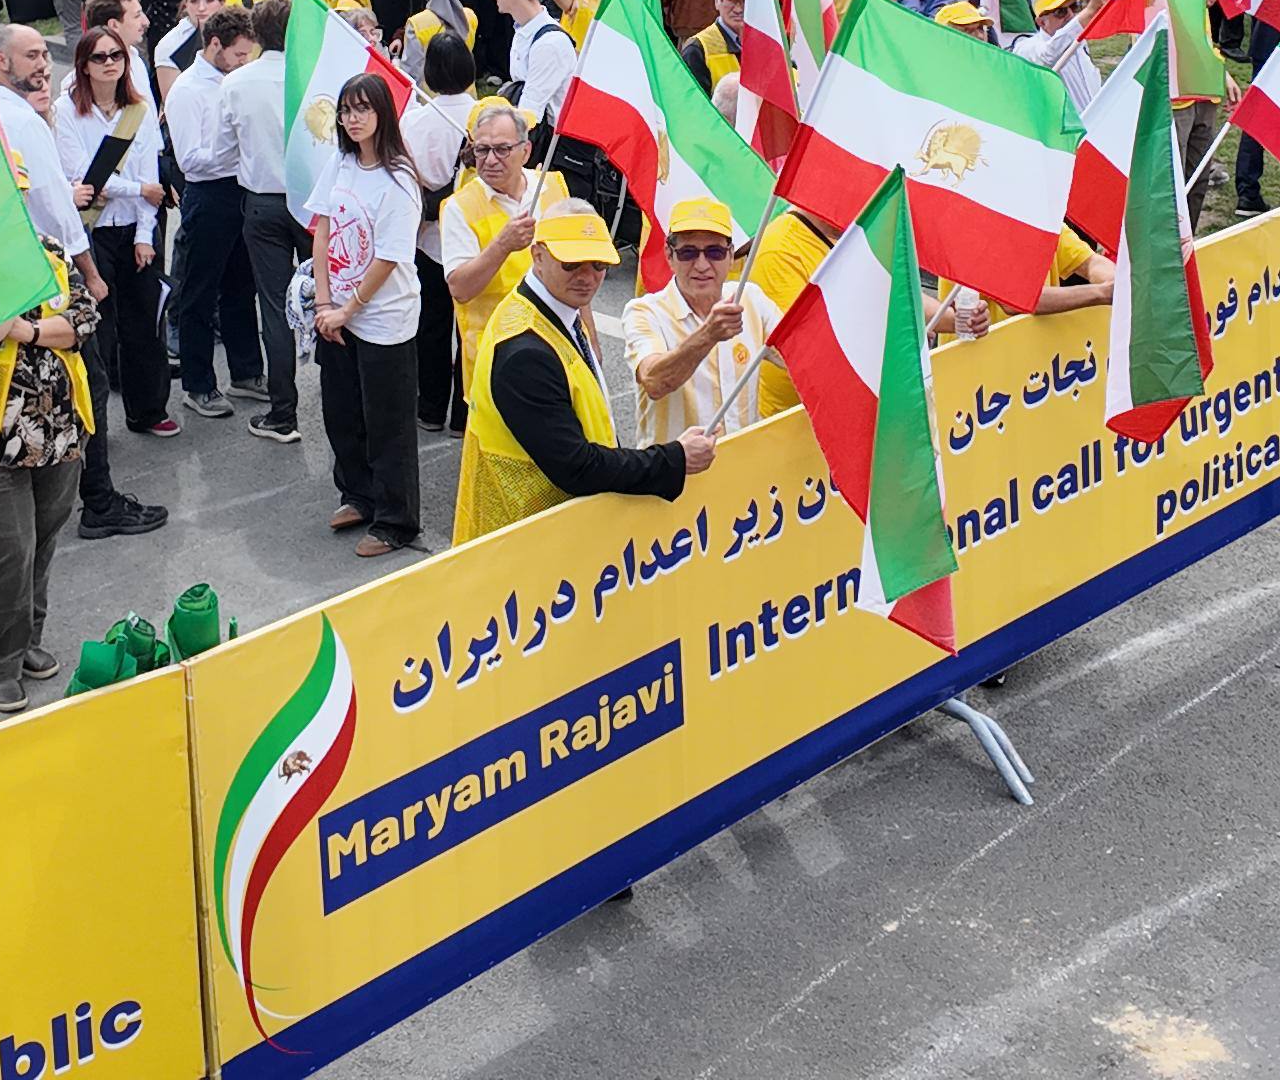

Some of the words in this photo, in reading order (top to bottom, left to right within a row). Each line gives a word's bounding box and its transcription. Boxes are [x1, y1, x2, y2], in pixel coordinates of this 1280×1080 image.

[948, 384, 1013, 453] جان
[1031, 439, 1104, 512] call
[723, 485, 785, 562] زیر
[592, 504, 710, 624] اعدام
[326, 749, 528, 881] Maryam
[538, 661, 676, 769] Rajavi
